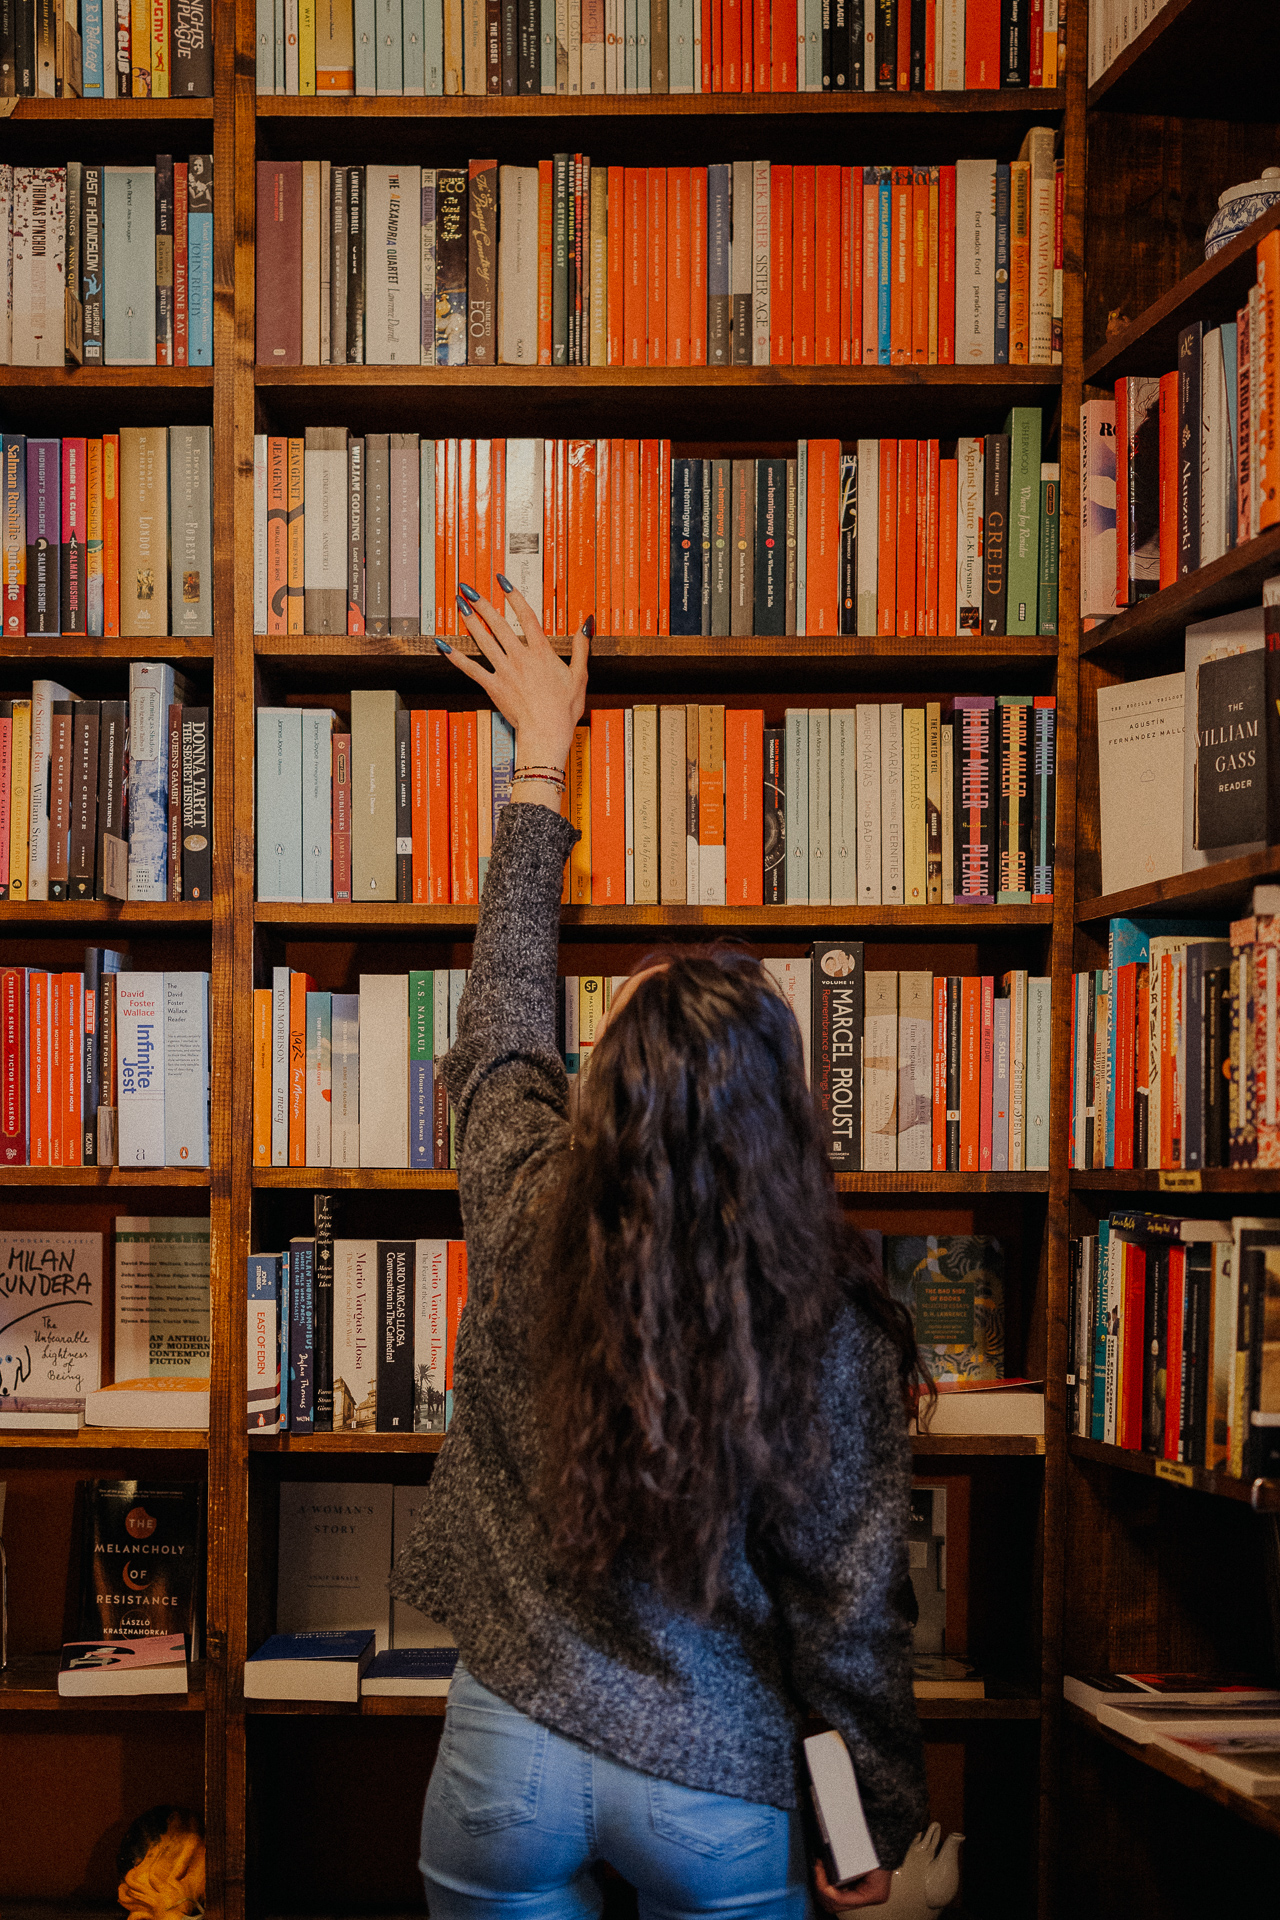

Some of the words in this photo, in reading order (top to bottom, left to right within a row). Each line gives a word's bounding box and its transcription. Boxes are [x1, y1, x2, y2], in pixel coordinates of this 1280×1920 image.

[174, 4, 191, 59] PLAGUE
[506, 6, 514, 56] Correction
[117, 31, 130, 74] CLUB
[490, 39, 498, 64] LOSER
[86, 171, 98, 194] EAST
[389, 174, 400, 189] THE
[557, 162, 565, 198] ERNAUX
[32, 184, 46, 216] THOMAS
[32, 219, 46, 256] PYNCHON
[386, 193, 400, 246] ALEXANDRIA
[757, 205, 767, 248] FISHER
[86, 209, 98, 271] HOUNDSLOW
[190, 243, 200, 271] JOHN
[387, 249, 398, 284] QUARTET
[756, 255, 767, 295] SISTER
[1038, 221, 1048, 297] CAMPAIGN
[191, 275, 200, 317] RECHY
[756, 300, 767, 328] AGE
[471, 301, 484, 337] ECO
[7, 444, 20, 488] Salman
[291, 441, 300, 467] JEAN
[1021, 422, 1030, 475] ISHERWOOD
[291, 468, 300, 500] GENET
[351, 446, 360, 491] WILLIAM
[966, 446, 979, 488] Against
[8, 492, 21, 540] Rushdie
[766, 487, 775, 536] hemingway
[967, 492, 978, 529] Nature
[1020, 486, 1031, 512] Where
[1182, 459, 1192, 550] Akuszerki
[351, 494, 360, 541] GOLDING
[1018, 514, 1030, 527] Joy
[186, 522, 198, 560] FOREST
[987, 512, 1003, 594] GREED
[1019, 528, 1029, 558] Resides
[6, 545, 21, 600] Quichotte
[38, 553, 46, 581] SALMAN
[70, 550, 78, 579] SALMAN
[965, 556, 975, 598] Huysmans
[38, 583, 46, 612] RUSHDIE
[70, 581, 78, 611] RUSHDIE
[1129, 718, 1165, 730] AGUSTÍN
[1228, 702, 1244, 712] THE
[35, 710, 44, 747] Suicide
[183, 722, 192, 741] THE
[910, 719, 920, 761] JAVIER
[963, 709, 989, 753] HENRY
[1002, 705, 1027, 746] HENRY
[34, 752, 43, 773] Run
[170, 731, 179, 769] QUEEN'S
[183, 743, 192, 782] SECRET
[193, 722, 205, 772] DONNA
[1215, 750, 1257, 773] GASS
[962, 759, 989, 809] MILLER
[1002, 751, 1026, 797] MILLER
[1218, 780, 1252, 793] READER
[32, 783, 42, 824] William
[183, 784, 192, 828] HISTORY
[193, 778, 206, 827] TARTT
[31, 827, 41, 862] Styron
[962, 844, 988, 896] PLEXUS
[1001, 851, 1026, 892] SEXUS
[129, 999, 154, 1007] Foster
[277, 989, 285, 1011] TONI
[822, 989, 831, 1051] Remembrance
[832, 989, 854, 1062] MARCEL
[137, 1024, 154, 1088] Infinite
[277, 1014, 285, 1063] MORRISON
[122, 1057, 138, 1094] Jest
[822, 1054, 830, 1063] of
[998, 1041, 1006, 1079] SOLLERS
[820, 1064, 830, 1091] Things
[275, 1096, 284, 1124] mercy
[822, 1094, 830, 1111] Past
[832, 1068, 853, 1138] PROUST
[8, 1247, 75, 1272] MILAN
[386, 1252, 395, 1301] Conversation
[396, 1252, 405, 1283] MARIO
[386, 1310, 395, 1325] The
[396, 1284, 405, 1317] VARGAS
[34, 1331, 90, 1344] Unbearable
[257, 1312, 265, 1334] EAST
[396, 1319, 405, 1347] LLOSA
[42, 1344, 88, 1366] Lightness
[257, 1336, 265, 1349] OF
[386, 1326, 395, 1363] Cathedral
[47, 1370, 82, 1392] Being
[257, 1351, 265, 1375] EDEN
[129, 1518, 153, 1529] THE
[314, 1525, 355, 1534] STORY
[94, 1544, 185, 1555] MELANCHOLY
[130, 1570, 147, 1579] OF
[97, 1595, 178, 1606] RESISTANCE
[122, 1618, 150, 1626] LÁSZLÓ
